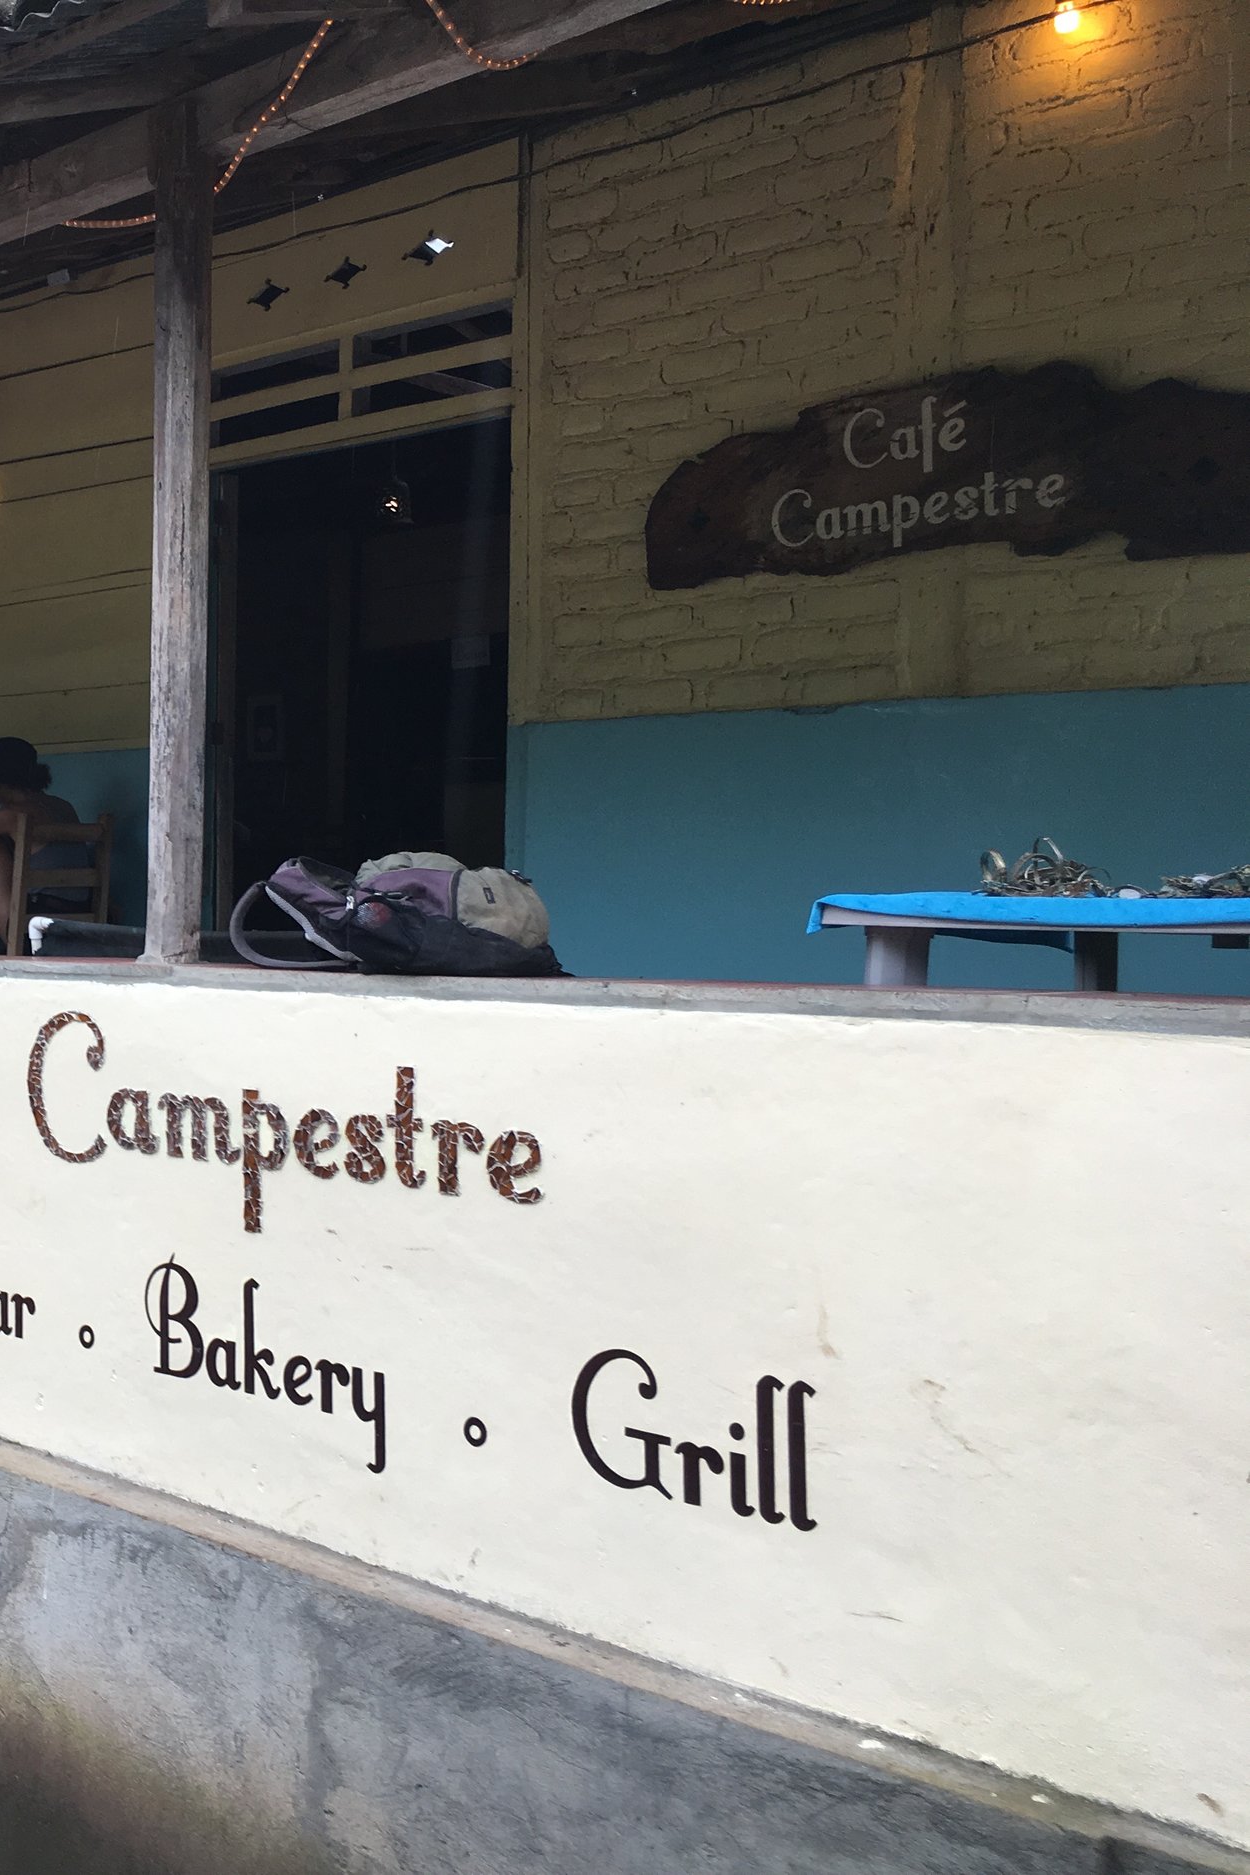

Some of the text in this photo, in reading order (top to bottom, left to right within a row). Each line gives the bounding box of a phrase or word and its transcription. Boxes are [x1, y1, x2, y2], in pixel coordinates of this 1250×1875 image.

[843, 396, 967, 472] Café
[771, 471, 1066, 548] Campestre
[26, 1011, 546, 1235] Campestre
[144, 1253, 386, 1474] Bakery
[571, 1349, 818, 1532] Grill
